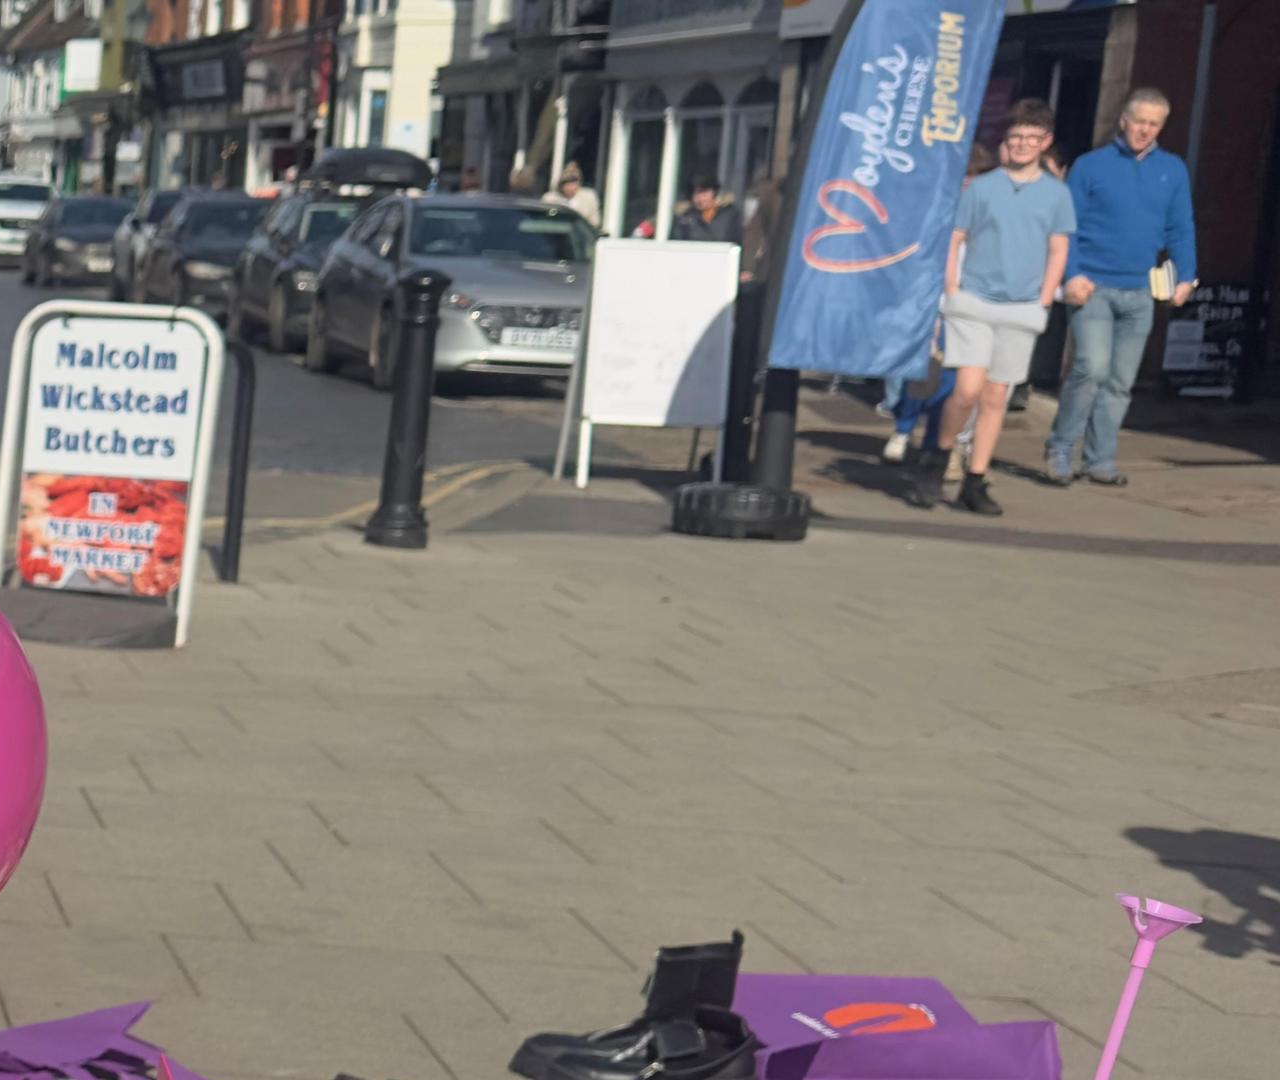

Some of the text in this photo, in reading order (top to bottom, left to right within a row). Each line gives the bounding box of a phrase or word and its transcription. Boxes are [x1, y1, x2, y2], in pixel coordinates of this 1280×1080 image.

[921, 11, 966, 147] EMPORIUM
[56, 343, 177, 370] Malcolm
[42, 385, 188, 415] Wickstead
[45, 426, 175, 457] Butchers
[53, 547, 145, 569] MARKET
